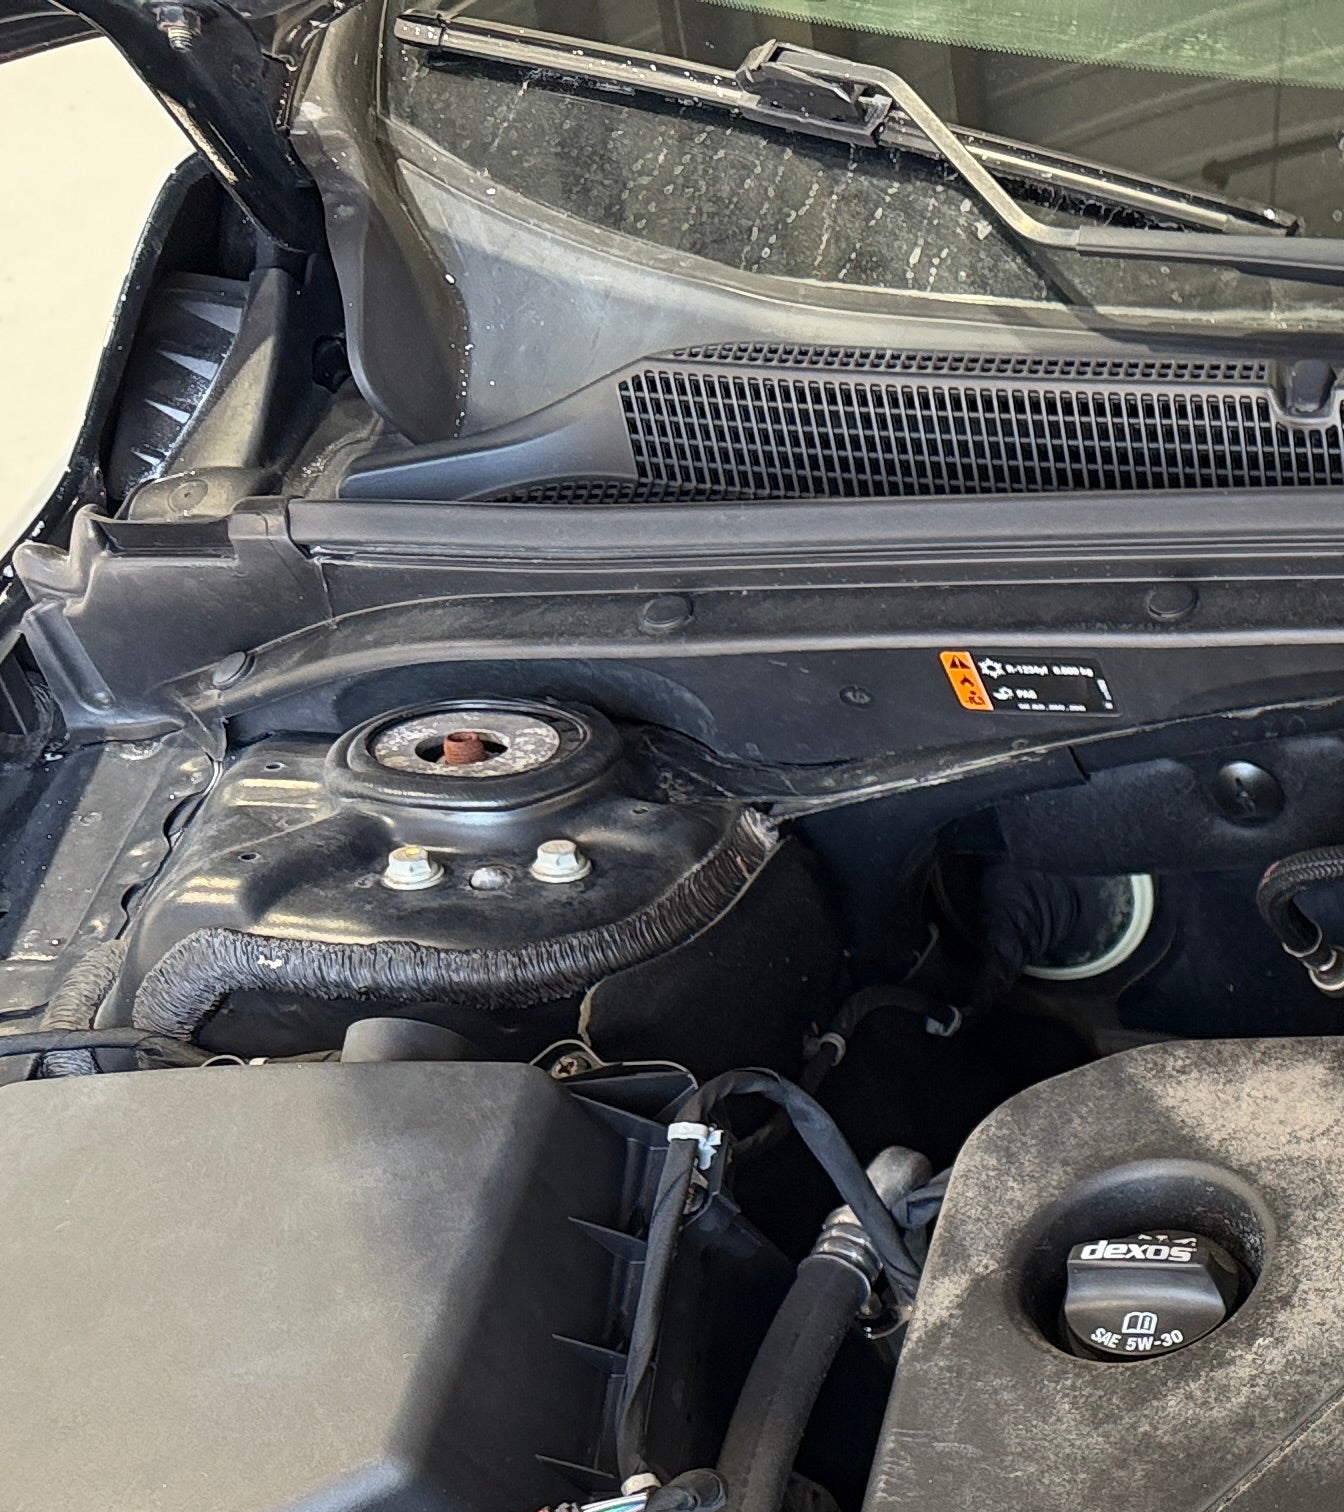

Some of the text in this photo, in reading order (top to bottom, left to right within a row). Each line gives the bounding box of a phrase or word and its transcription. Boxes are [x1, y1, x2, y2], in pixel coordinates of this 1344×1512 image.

[1080, 1239, 1197, 1263] dexos
[1090, 1327, 1184, 1352] SAE 5W-30
